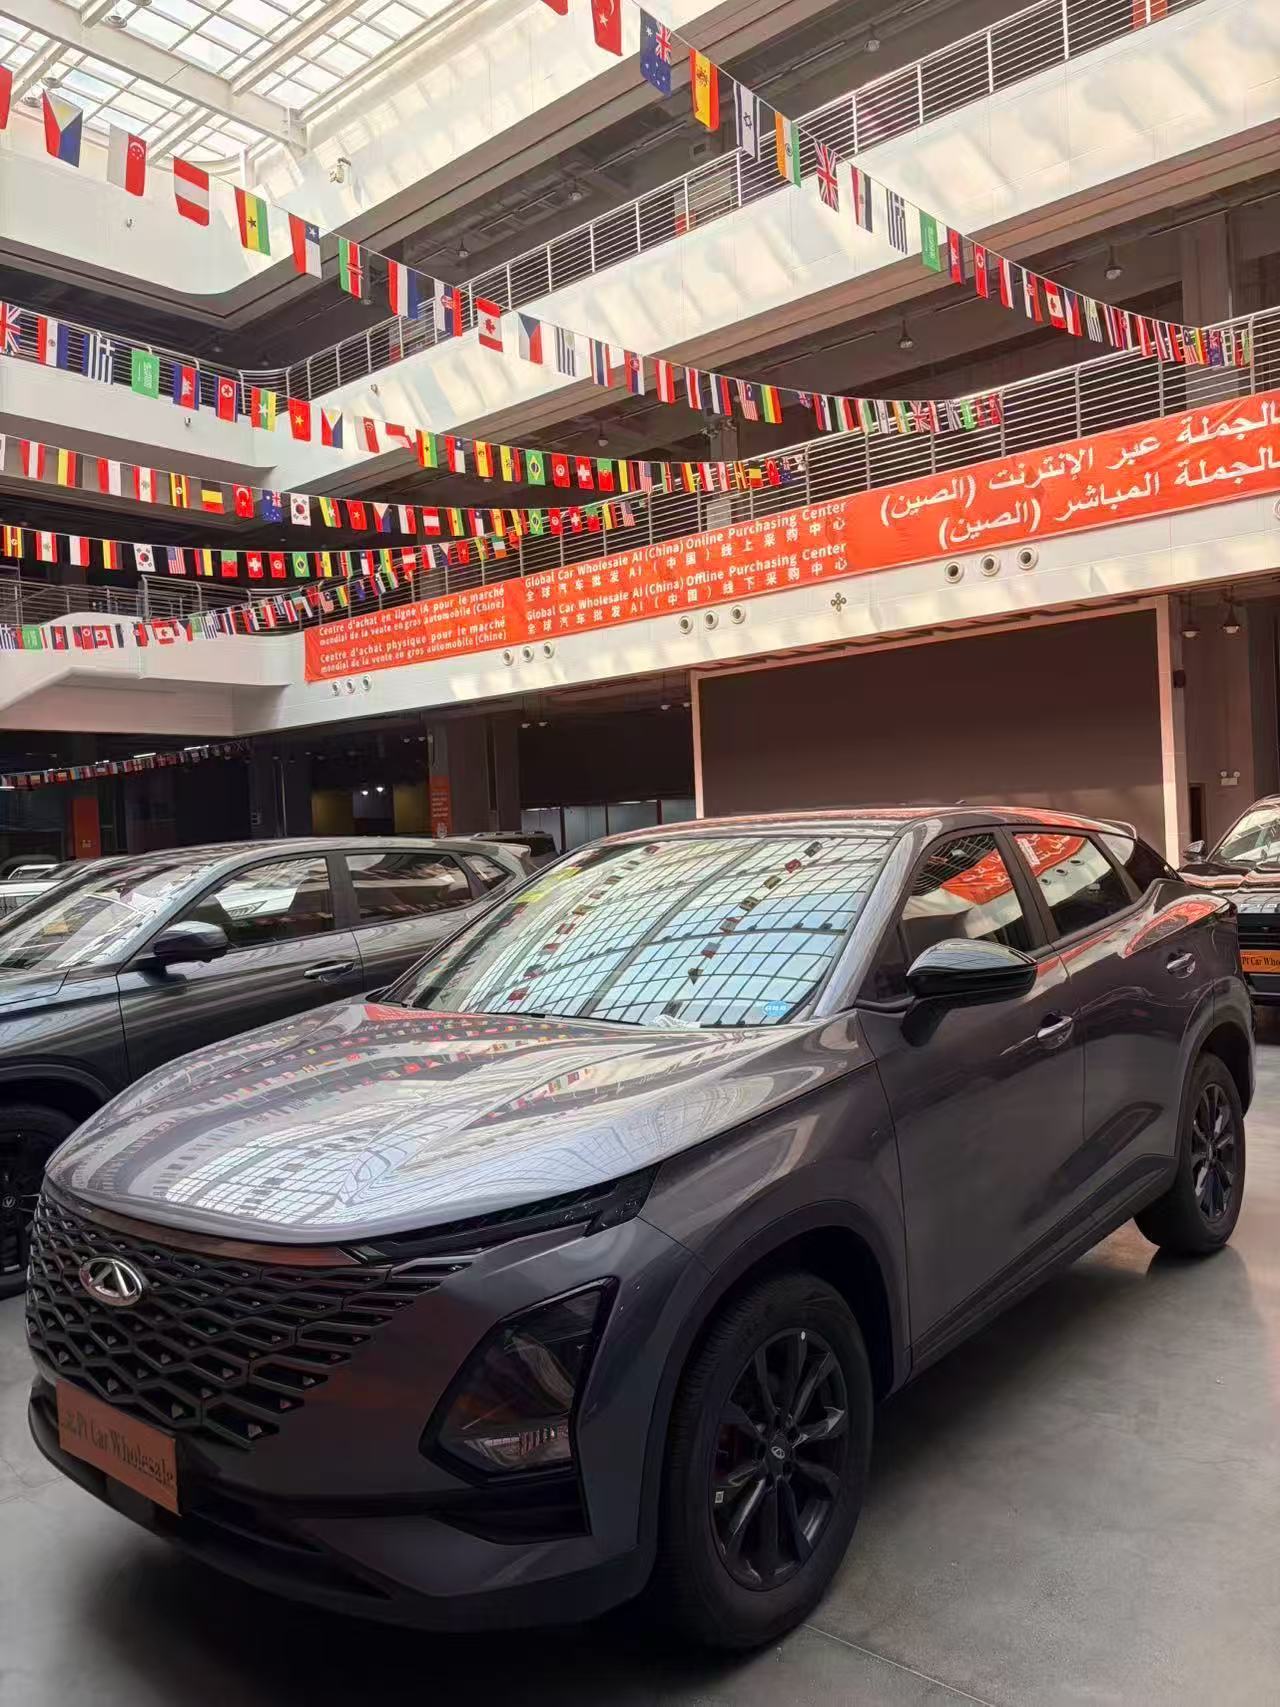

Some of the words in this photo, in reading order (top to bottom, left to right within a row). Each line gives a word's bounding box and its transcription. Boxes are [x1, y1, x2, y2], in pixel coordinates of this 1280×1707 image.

[1176, 400, 1280, 444] الجملة
[989, 447, 1093, 490] الإنترنت
[1106, 436, 1161, 470] عبر
[1174, 445, 1280, 487] الجملة
[880, 474, 977, 527] (الصين)
[1055, 471, 1160, 522] المباشر
[525, 572, 555, 589] Global
[557, 569, 574, 581] Car
[577, 555, 629, 576] Wholesale
[632, 551, 643, 564] AI
[645, 542, 684, 560] (China)
[686, 532, 724, 549] Online
[728, 514, 797, 539] Purchasing
[802, 501, 847, 521] Center
[938, 498, 1041, 551] (الصين)
[527, 605, 556, 621] Global
[559, 602, 574, 614] Car
[578, 590, 629, 609] Wholesale
[632, 587, 643, 598] AI
[645, 577, 684, 596] (China)
[686, 569, 724, 587] Offline
[729, 552, 797, 577] Purchasing
[802, 542, 847, 561] Center
[320, 625, 345, 636] Centre
[348, 616, 377, 630] d'achat
[381, 613, 392, 623] en
[394, 608, 416, 621] ligne
[433, 599, 454, 612] pour
[458, 594, 467, 605] le
[470, 584, 504, 602] marché
[320, 635, 348, 646] mondial
[350, 631, 359, 640] de
[361, 629, 369, 638] la
[371, 624, 392, 635] vente
[393, 622, 403, 631] en
[404, 618, 421, 630] gros
[424, 606, 471, 625] automobile
[473, 598, 505, 615] (Chine)
[321, 651, 347, 663] Centre
[351, 643, 382, 657] d'achat
[386, 635, 426, 652] physique
[431, 630, 452, 643] pour
[457, 625, 466, 636] le
[469, 616, 505, 634] marché
[351, 658, 360, 667] de
[362, 656, 369, 665] la
[407, 647, 424, 659] gros
[426, 637, 473, 653] automobile
[475, 630, 507, 646] (Chine)
[1251, 956, 1262, 966] Car
[91, 1418, 108, 1452] Car
[110, 1429, 175, 1487] Wholesale
